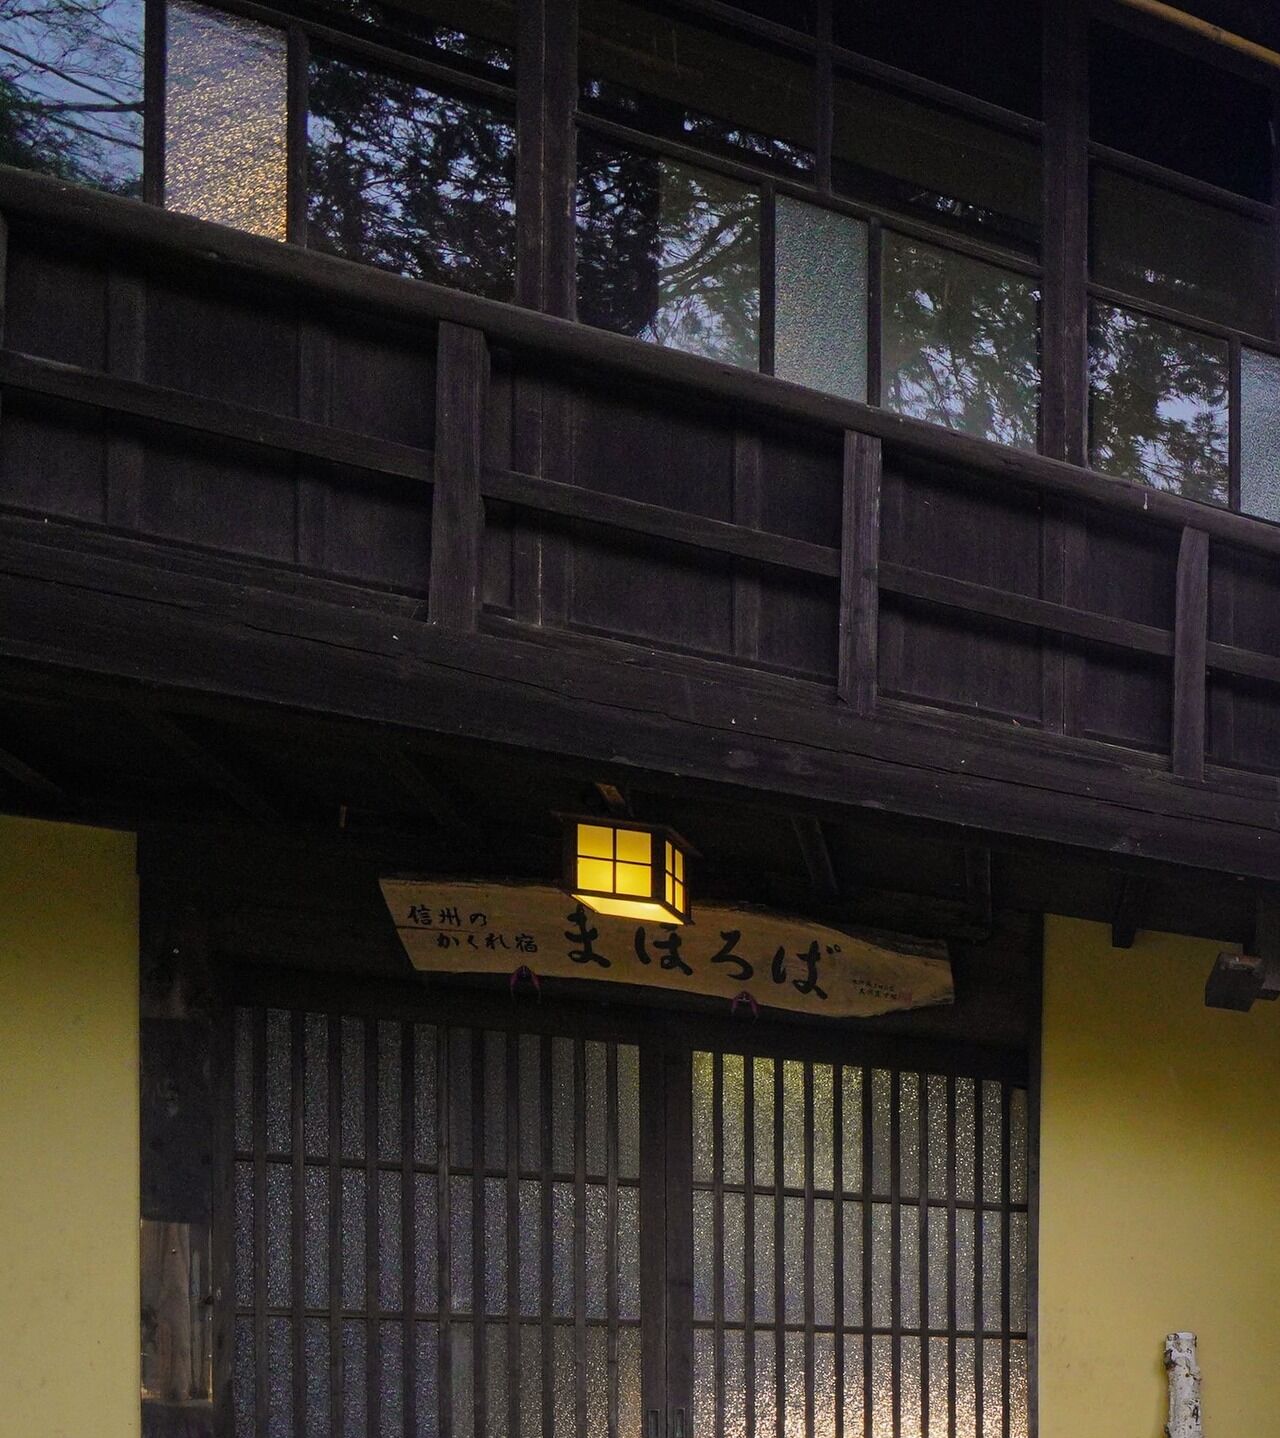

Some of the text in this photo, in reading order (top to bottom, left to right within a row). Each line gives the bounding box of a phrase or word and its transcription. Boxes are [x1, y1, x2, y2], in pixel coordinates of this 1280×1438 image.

[408, 904, 488, 927] 信州の
[437, 932, 538, 953] かくれ宿
[564, 904, 842, 1000] まほろば
